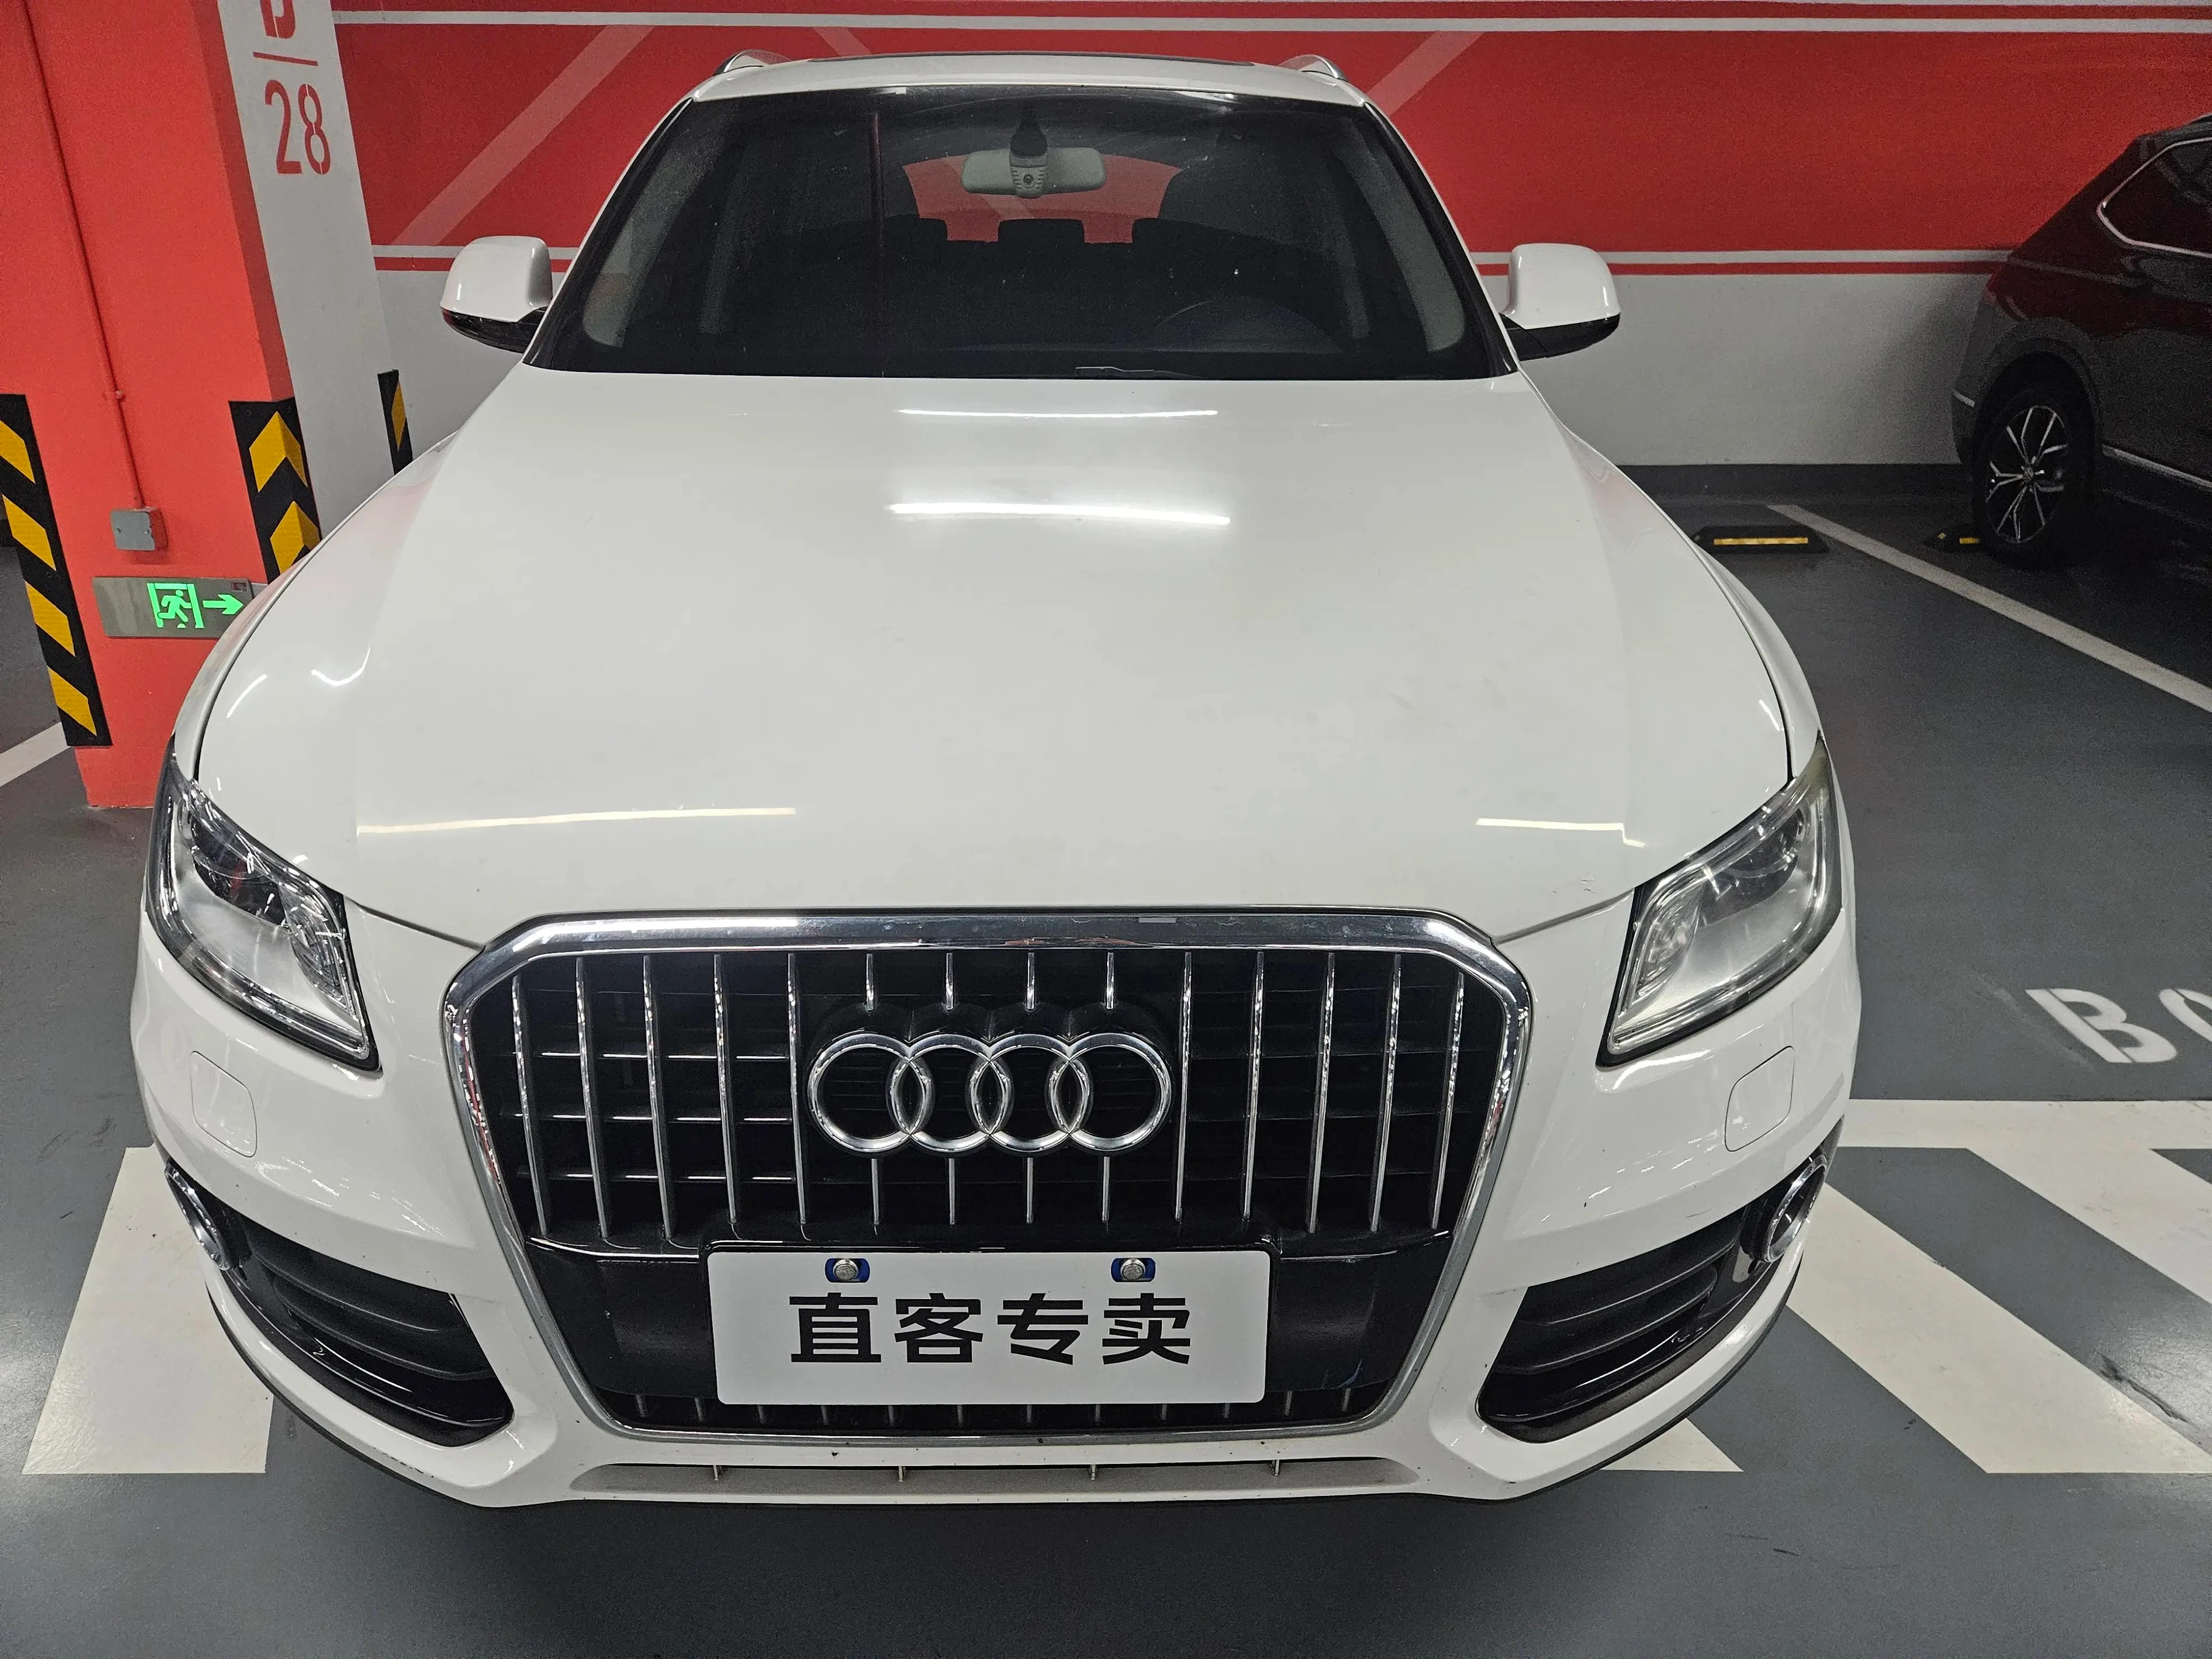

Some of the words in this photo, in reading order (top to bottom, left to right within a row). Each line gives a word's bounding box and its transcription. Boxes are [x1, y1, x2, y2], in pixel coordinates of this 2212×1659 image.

[265, 79, 331, 175] 28
[789, 1292, 1191, 1365] 直客专卖
